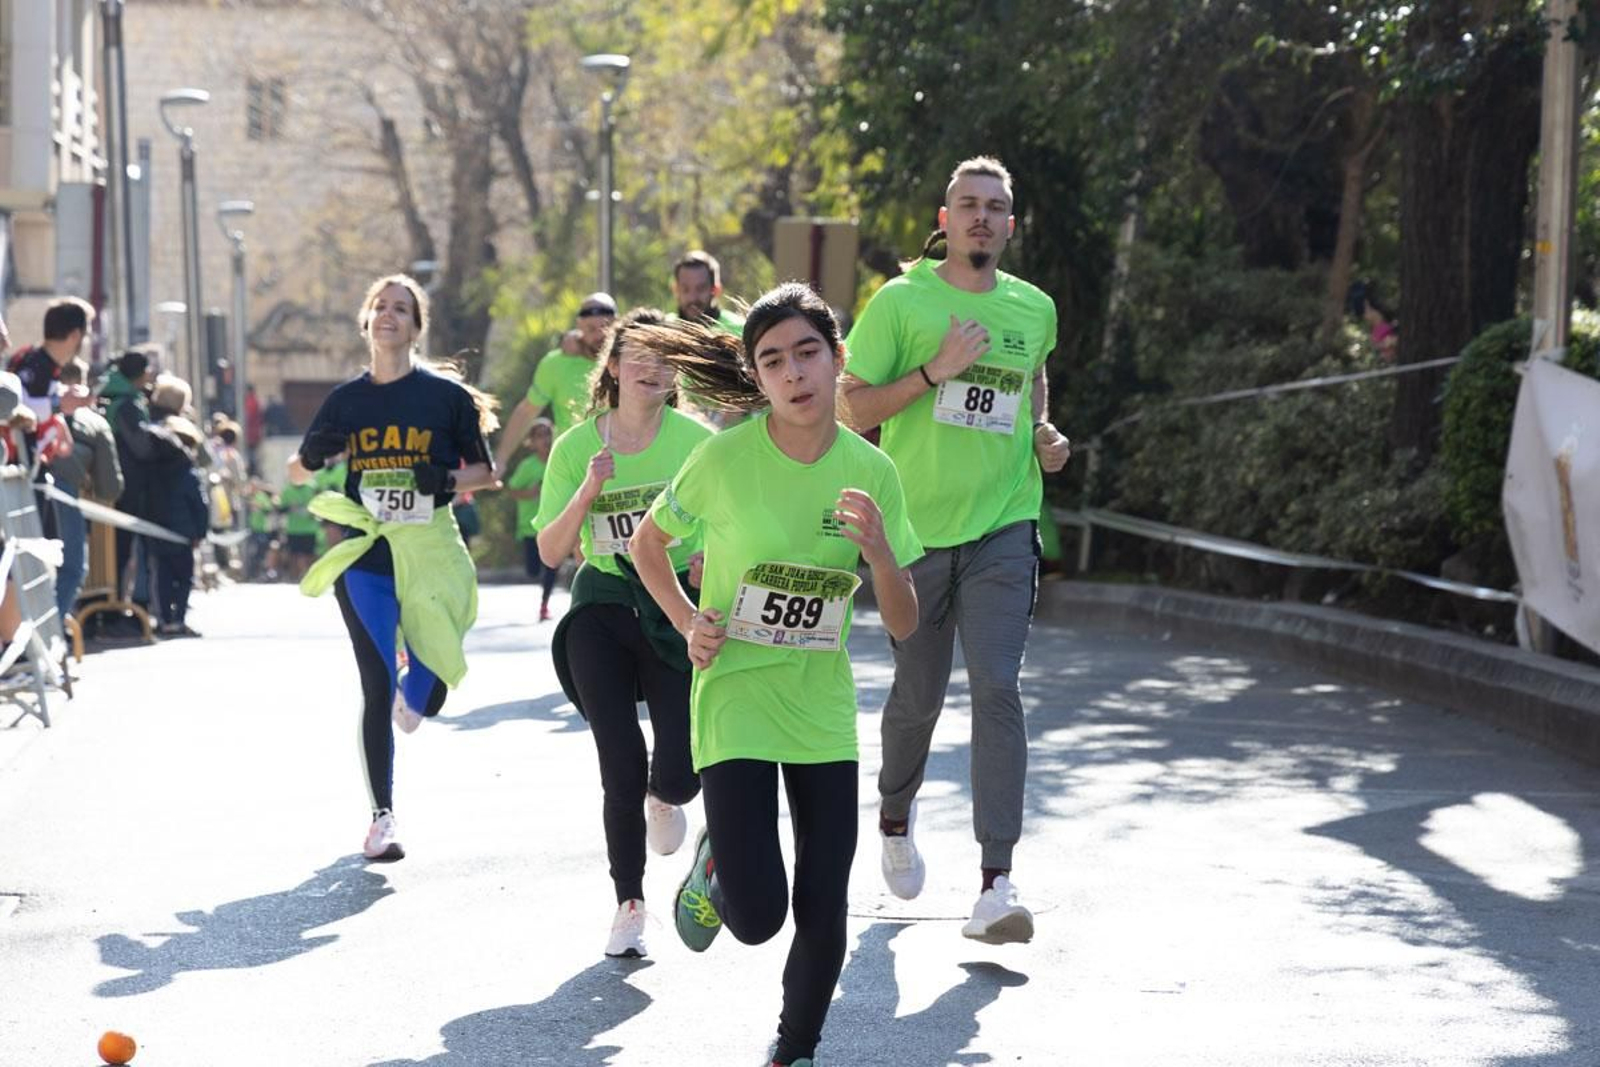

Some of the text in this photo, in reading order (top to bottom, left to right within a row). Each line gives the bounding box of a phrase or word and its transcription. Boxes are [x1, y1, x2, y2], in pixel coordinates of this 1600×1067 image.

[964, 386, 995, 414] 88
[351, 455, 430, 471] IVERSID
[375, 489, 415, 511] 750
[769, 564, 783, 575] SAN
[784, 566, 806, 579] JUAN
[760, 573, 790, 589] CARRERA
[791, 579, 819, 592] POPULAR
[761, 592, 824, 629] 589
